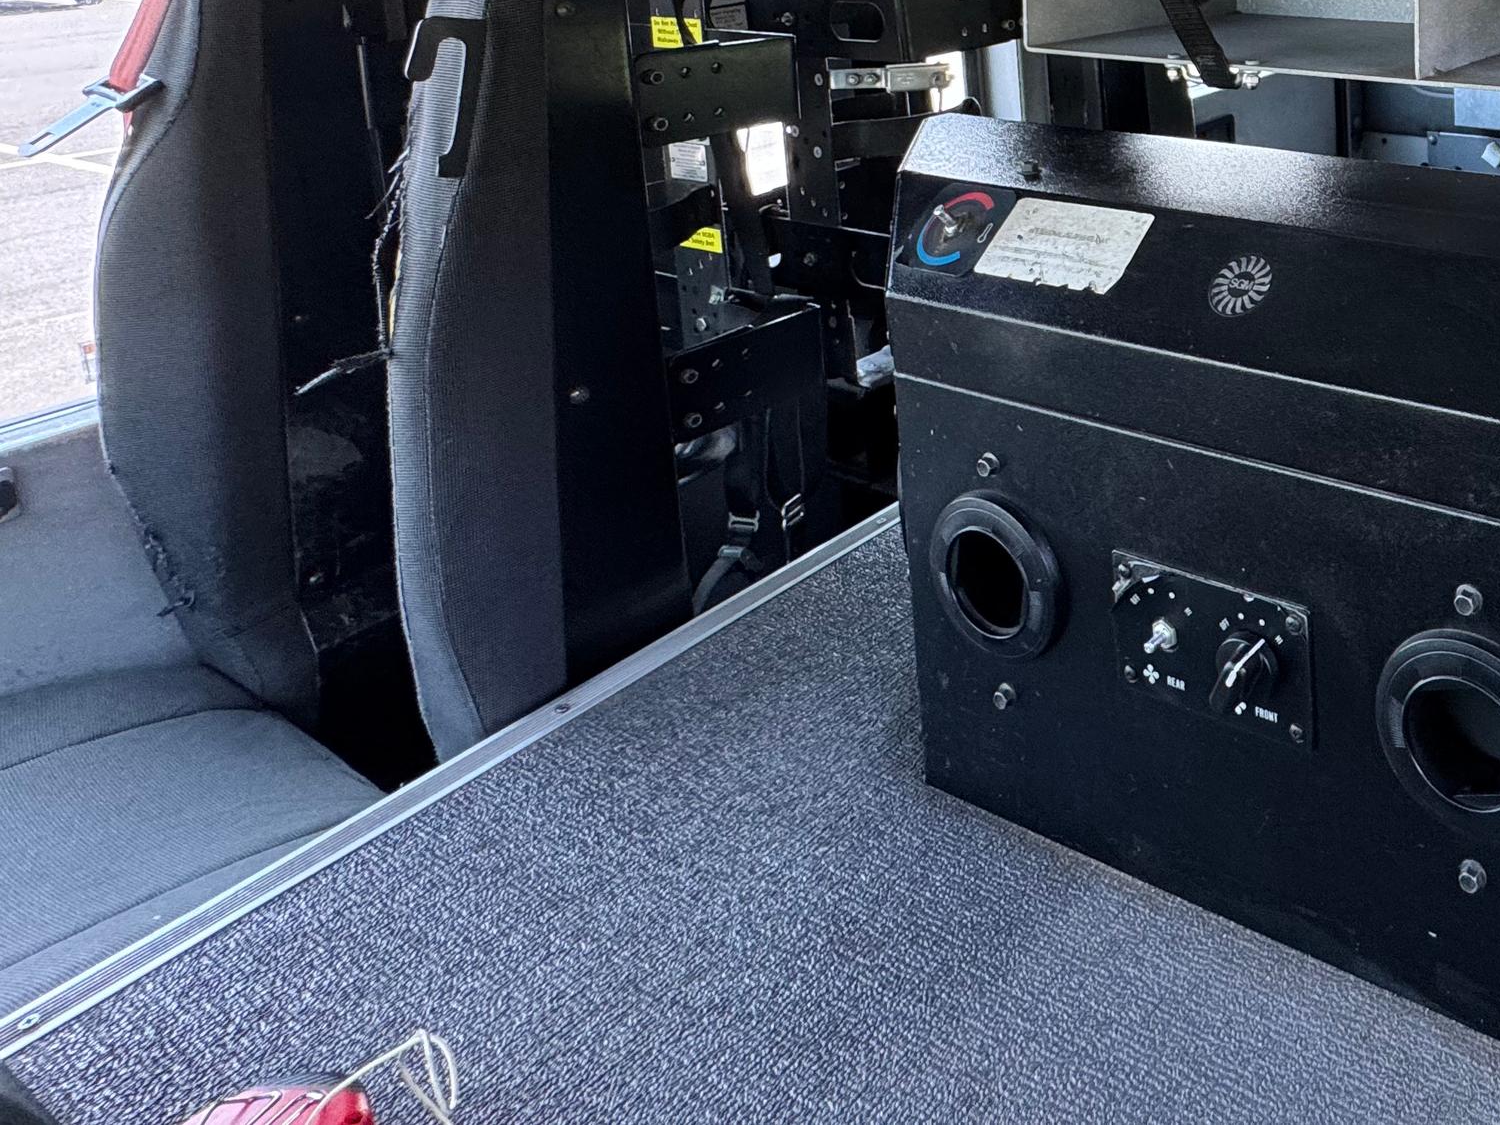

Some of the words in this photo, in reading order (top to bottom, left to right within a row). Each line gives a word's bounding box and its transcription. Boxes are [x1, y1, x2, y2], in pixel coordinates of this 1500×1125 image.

[1228, 277, 1256, 291] SQM
[1167, 675, 1186, 691] REAR
[1254, 706, 1279, 723] FRONT
